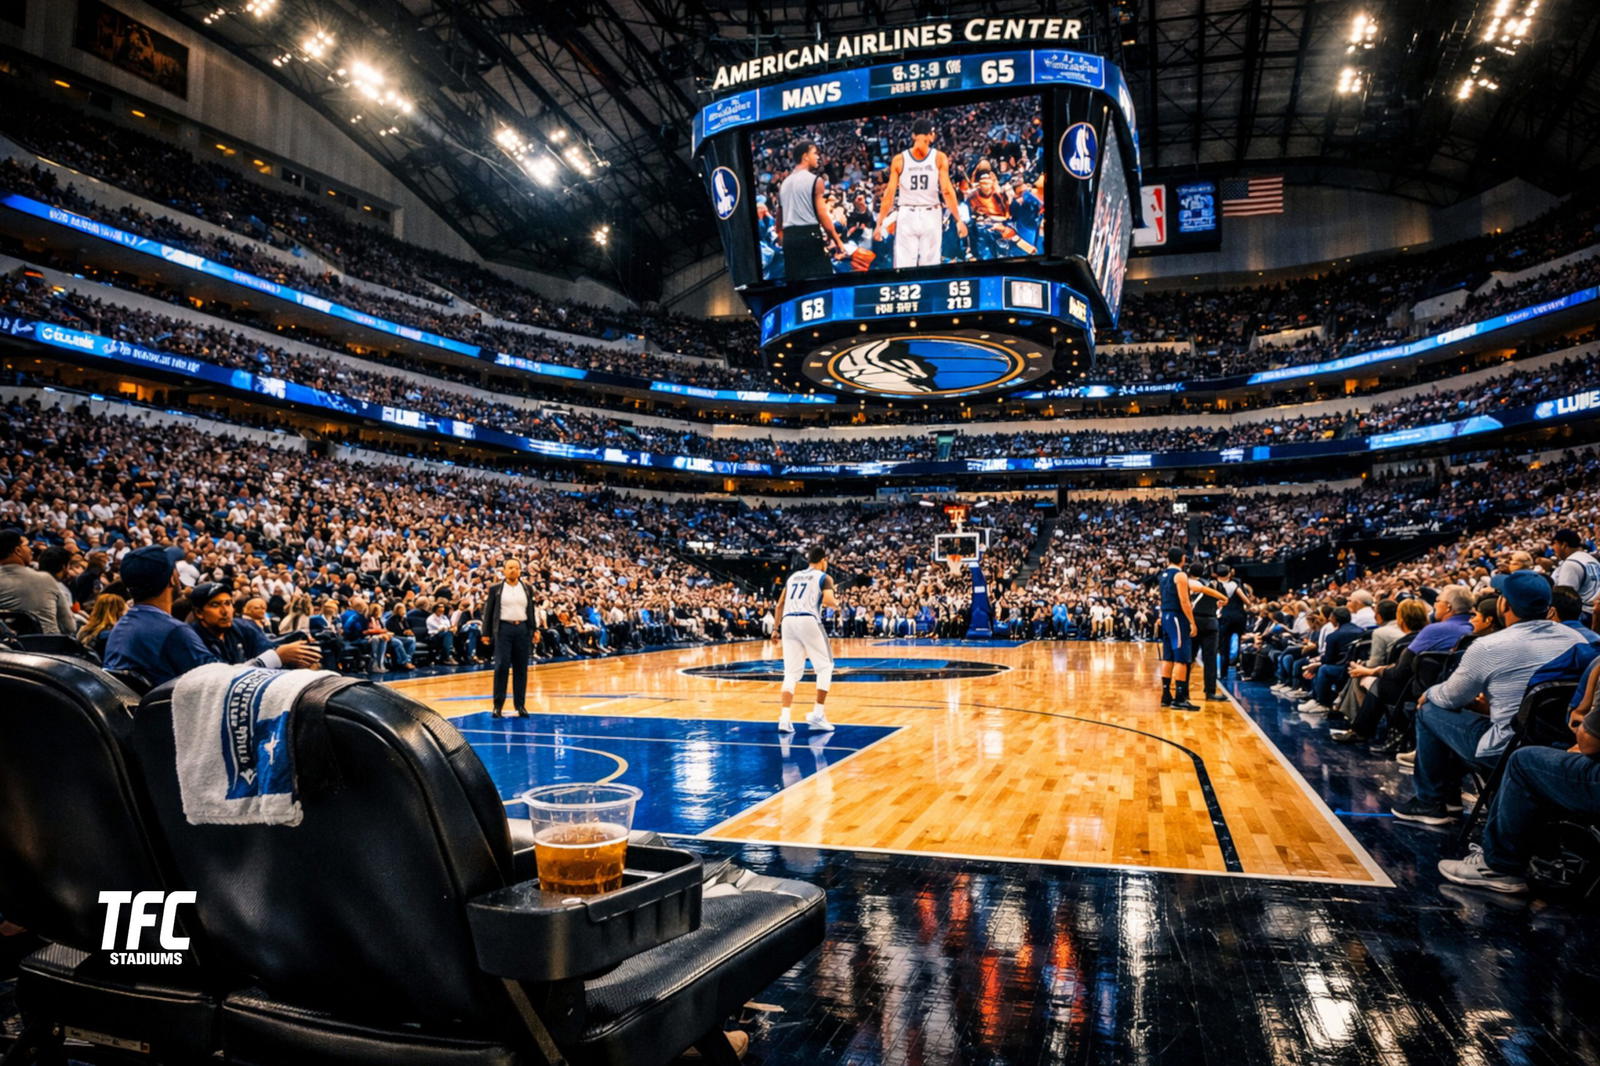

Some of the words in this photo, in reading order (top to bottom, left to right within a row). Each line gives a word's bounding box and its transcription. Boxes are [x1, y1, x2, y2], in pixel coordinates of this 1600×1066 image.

[712, 42, 829, 90] AMERICAN
[835, 23, 953, 60] AIRLINES
[964, 18, 1082, 42] CENTER
[981, 59, 1014, 85] 65
[782, 81, 842, 111] MAVS
[790, 582, 808, 600] 77
